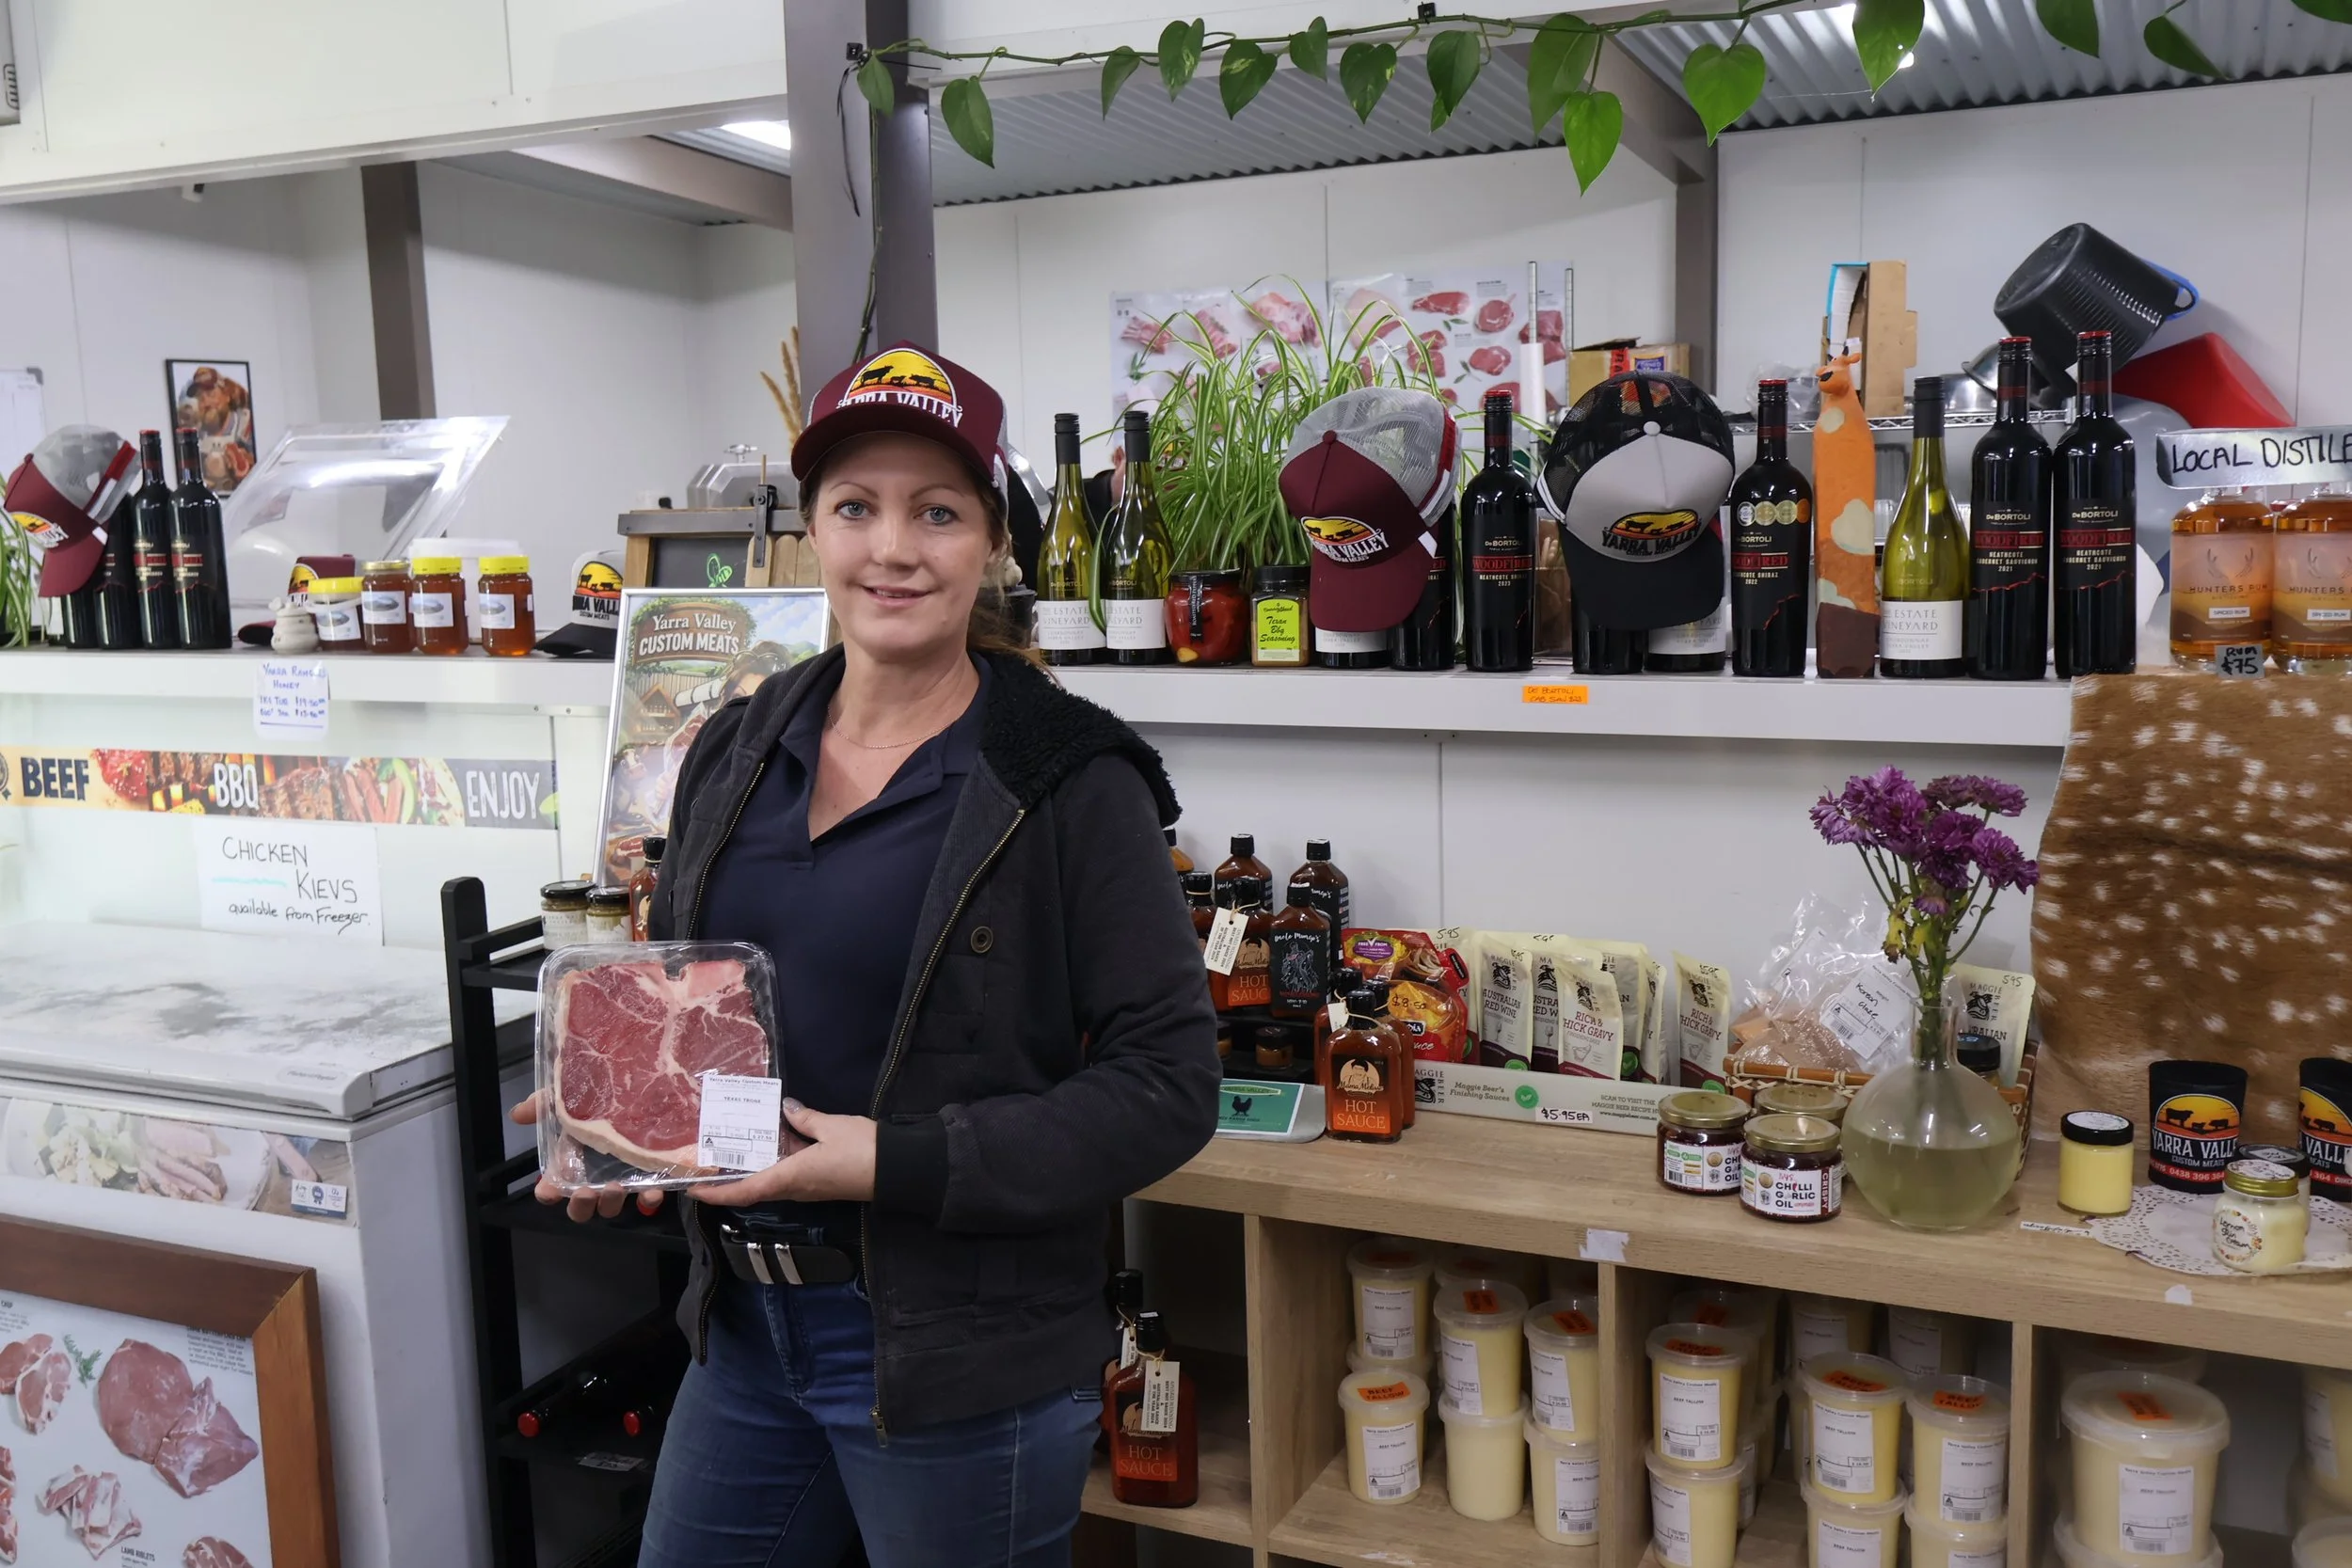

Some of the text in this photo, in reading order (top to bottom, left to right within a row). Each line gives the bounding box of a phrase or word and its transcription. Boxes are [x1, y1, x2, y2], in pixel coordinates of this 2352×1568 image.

[2171, 444, 2252, 473] LOCAL
[1339, 531, 1390, 558] VALLEY
[1601, 527, 1648, 552] YARRA
[2189, 585, 2244, 594] HUNTERS
[1266, 616, 1286, 625] Texan
[1894, 610, 1937, 619] ESTATE
[652, 612, 737, 634] Yarra Valley
[639, 632, 739, 656] CUSTOM MEATS
[1260, 634, 1295, 643] Seasoning
[2221, 657, 2258, 675] $75
[21, 757, 90, 801] BEEF
[214, 761, 260, 809] BBQ
[465, 769, 541, 820] ENJOY
[221, 837, 309, 868] CHICKEN
[295, 869, 358, 904] KIEVS
[228, 903, 279, 920] available
[285, 906, 314, 924] from
[1240, 974, 1268, 988] HOT
[1970, 982, 2002, 994] MAGGIE
[1232, 989, 1269, 1002] SAUC
[1483, 989, 1521, 1009] AUSTRALIAN
[1856, 983, 1878, 1006] Korean
[1485, 999, 1517, 1019] RED WINE
[1691, 1008, 1708, 1023] RICH
[1575, 1011, 1596, 1025] RICH
[1587, 1027, 1613, 1041] GRAVY
[1415, 1069, 1444, 1078] AGGIE
[1450, 1089, 1510, 1101] Finishing Sauces
[1454, 1082, 1481, 1093] Maggie
[1345, 1100, 1376, 1114] HOT
[1337, 1114, 1385, 1129] SAUCE
[2153, 1130, 2193, 1158] YARRA
[2171, 1156, 2201, 1166] CUSTOM
[2169, 1167, 2190, 1179] 0438
[1775, 1200, 1793, 1209] OIL
[1129, 1445, 1163, 1460] HOT
[1120, 1459, 1172, 1477] SAUCE
[120, 1546, 135, 1556] LAMB
